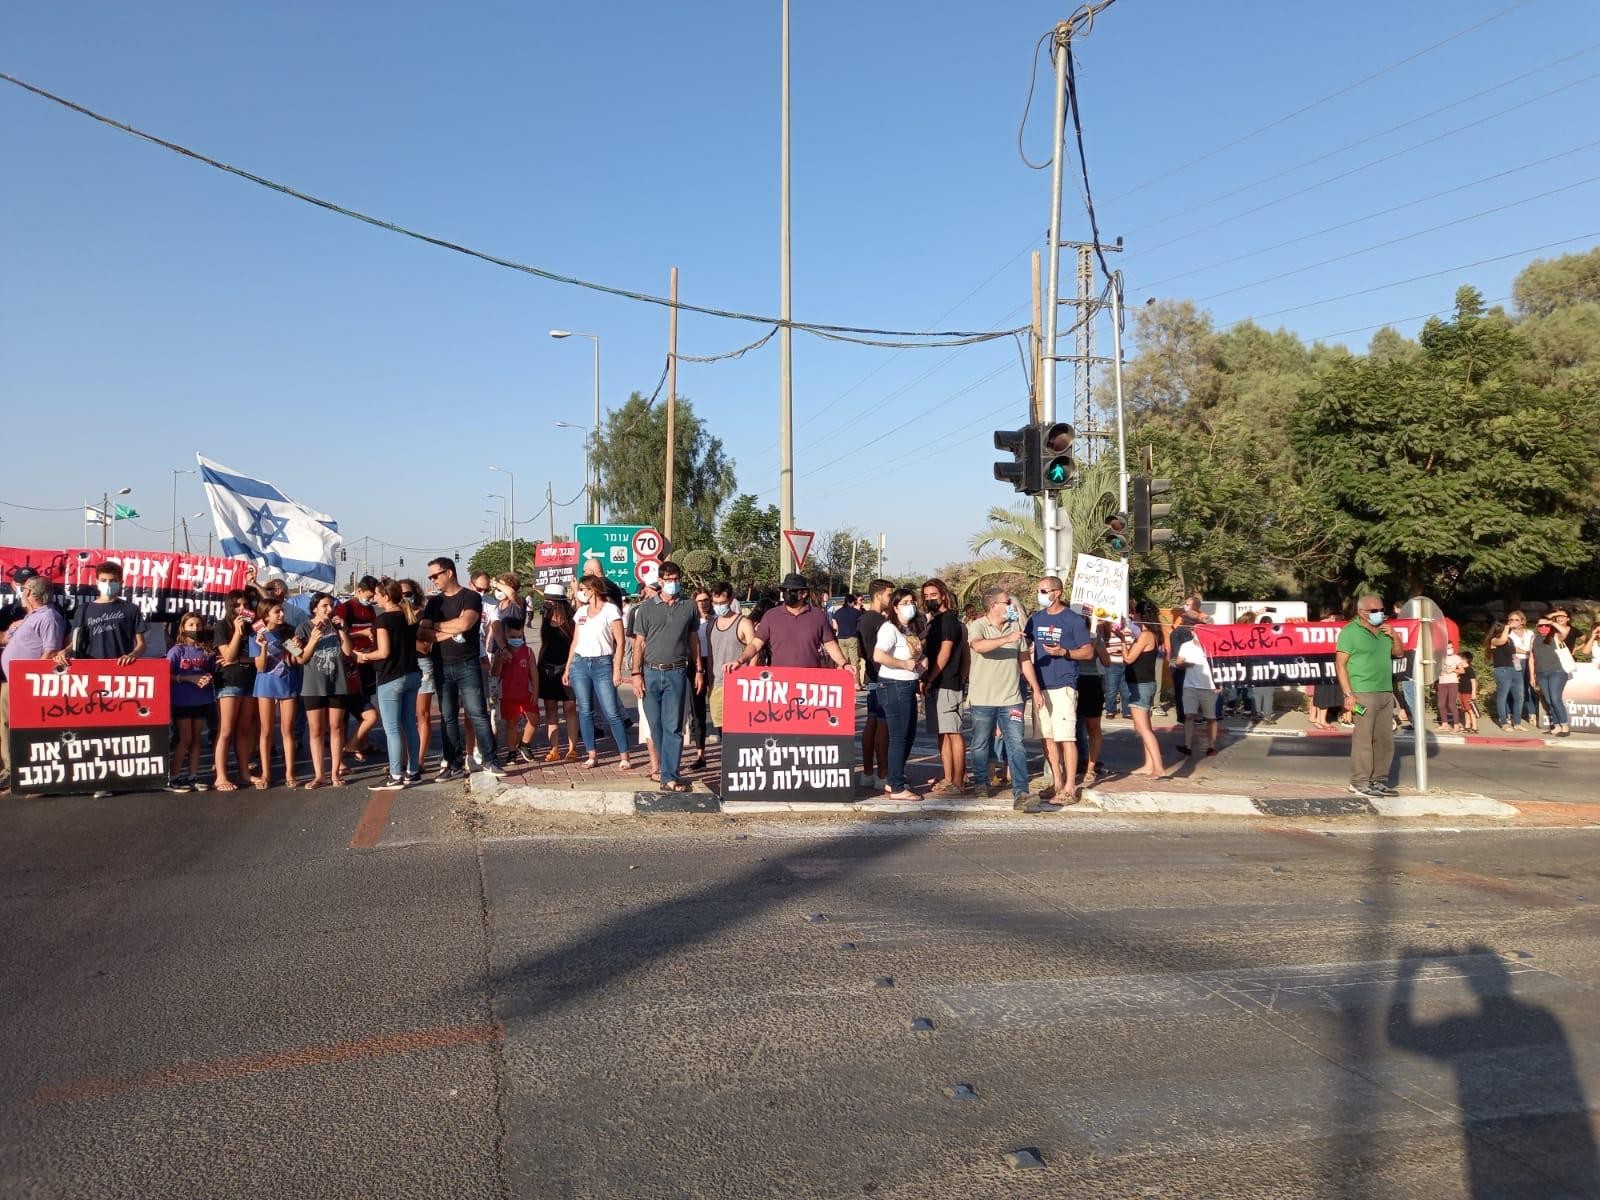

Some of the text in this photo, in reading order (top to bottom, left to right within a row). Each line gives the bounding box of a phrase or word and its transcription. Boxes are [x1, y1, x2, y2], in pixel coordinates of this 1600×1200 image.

[603, 533, 629, 542] עומר
[638, 538, 656, 551] 70
[177, 562, 232, 585] הנגב
[1296, 626, 1342, 644] ומר
[1212, 662, 1247, 683] לנגב
[1251, 660, 1321, 683] המשילות
[25, 672, 154, 698] הנגב אומר
[736, 678, 843, 708] הנגב אומר
[29, 734, 150, 762] מחזירים את
[737, 745, 839, 768] מחזירים את
[18, 755, 164, 786] המשילות לנגב
[727, 765, 851, 791] המשילות לנגב
